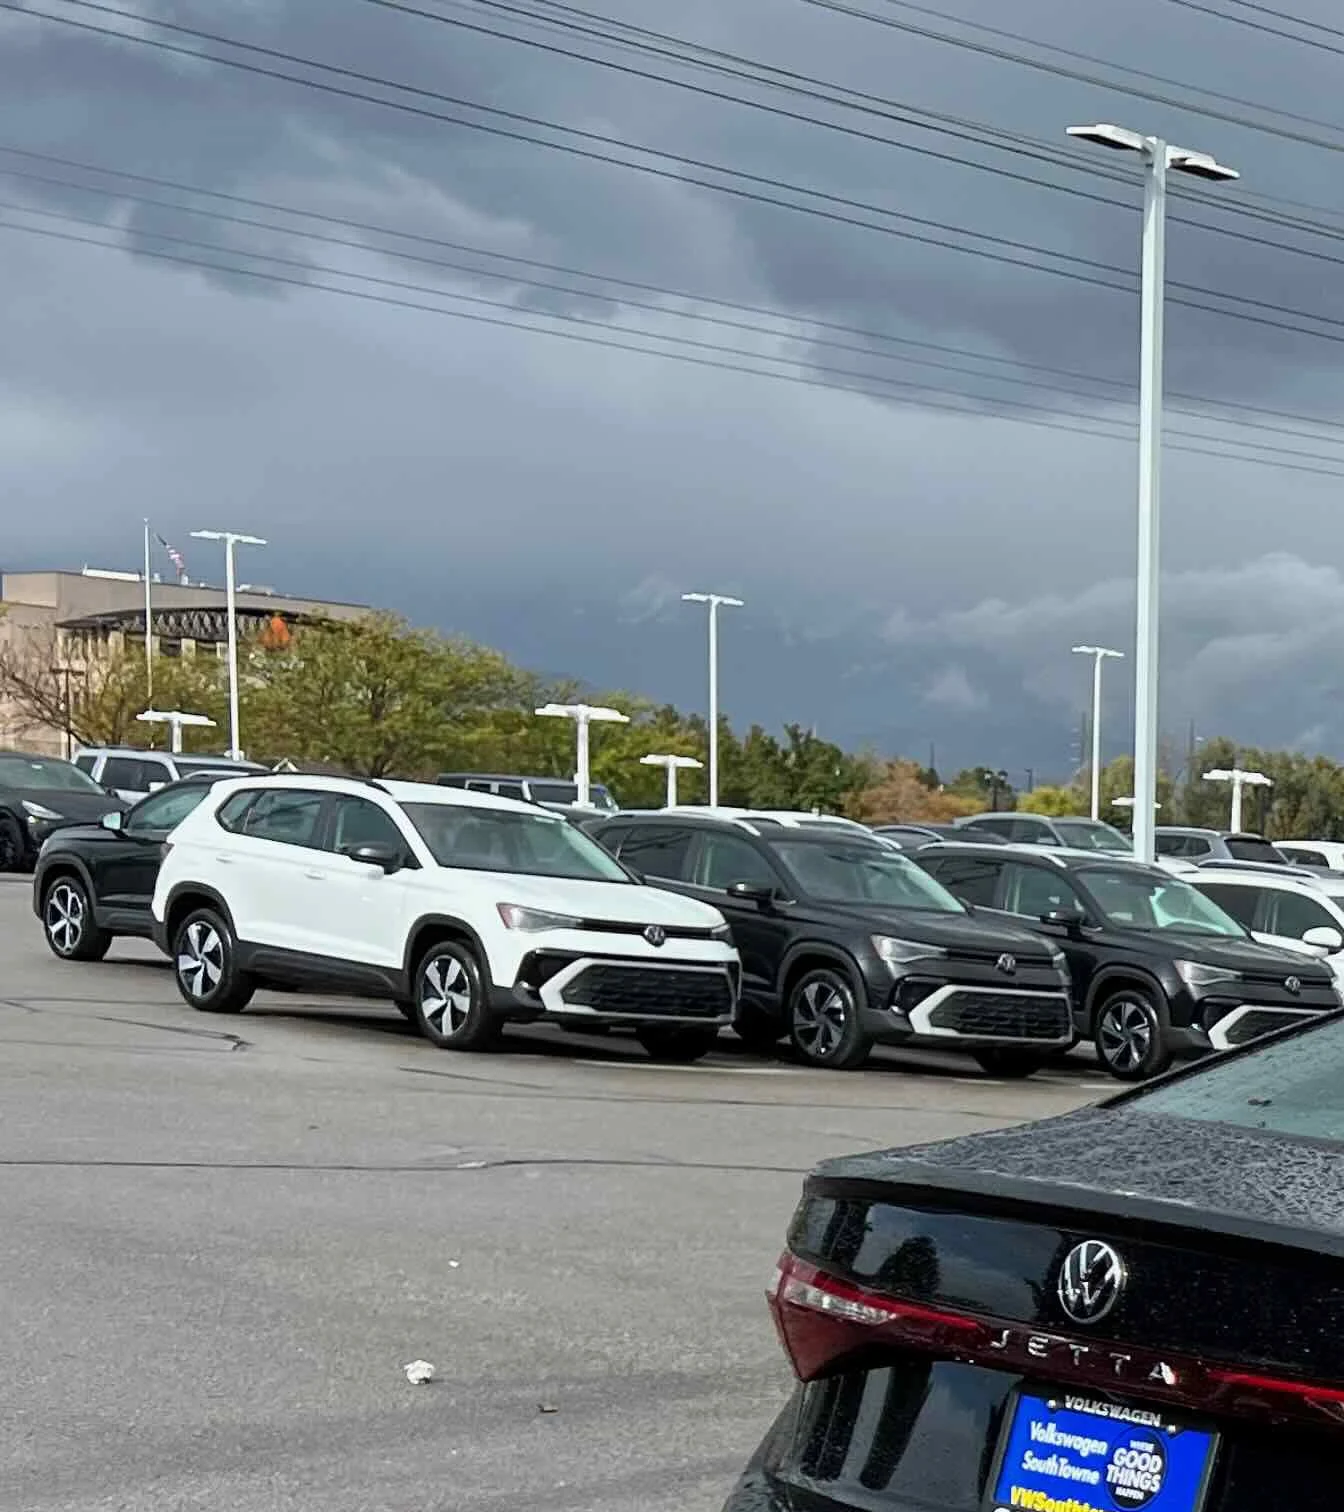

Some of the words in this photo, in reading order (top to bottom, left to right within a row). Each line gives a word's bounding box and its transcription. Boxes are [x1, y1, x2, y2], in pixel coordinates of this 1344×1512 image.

[991, 1330, 1176, 1385] JETTA
[1065, 1395, 1162, 1427] VOLKSWAGEN
[1030, 1421, 1108, 1457] Volkswagen
[1113, 1447, 1163, 1473] GOOD
[1106, 1464, 1161, 1492] THINGS
